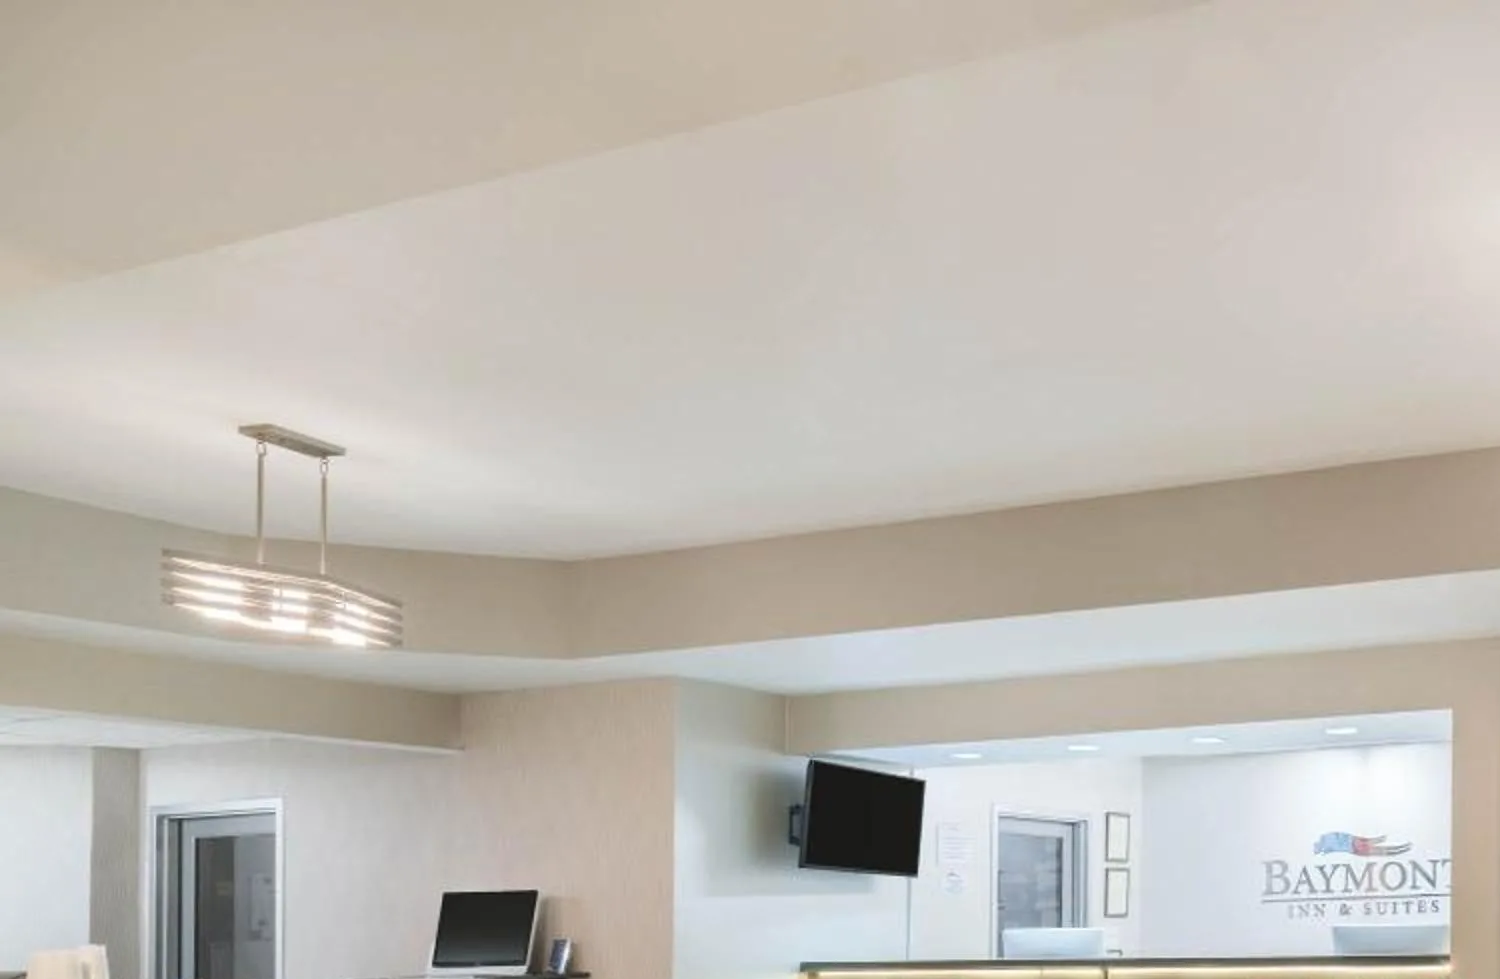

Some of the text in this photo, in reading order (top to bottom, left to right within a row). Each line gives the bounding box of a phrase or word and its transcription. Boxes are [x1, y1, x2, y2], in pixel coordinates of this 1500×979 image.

[1287, 900, 1440, 919] INN & SUITES
